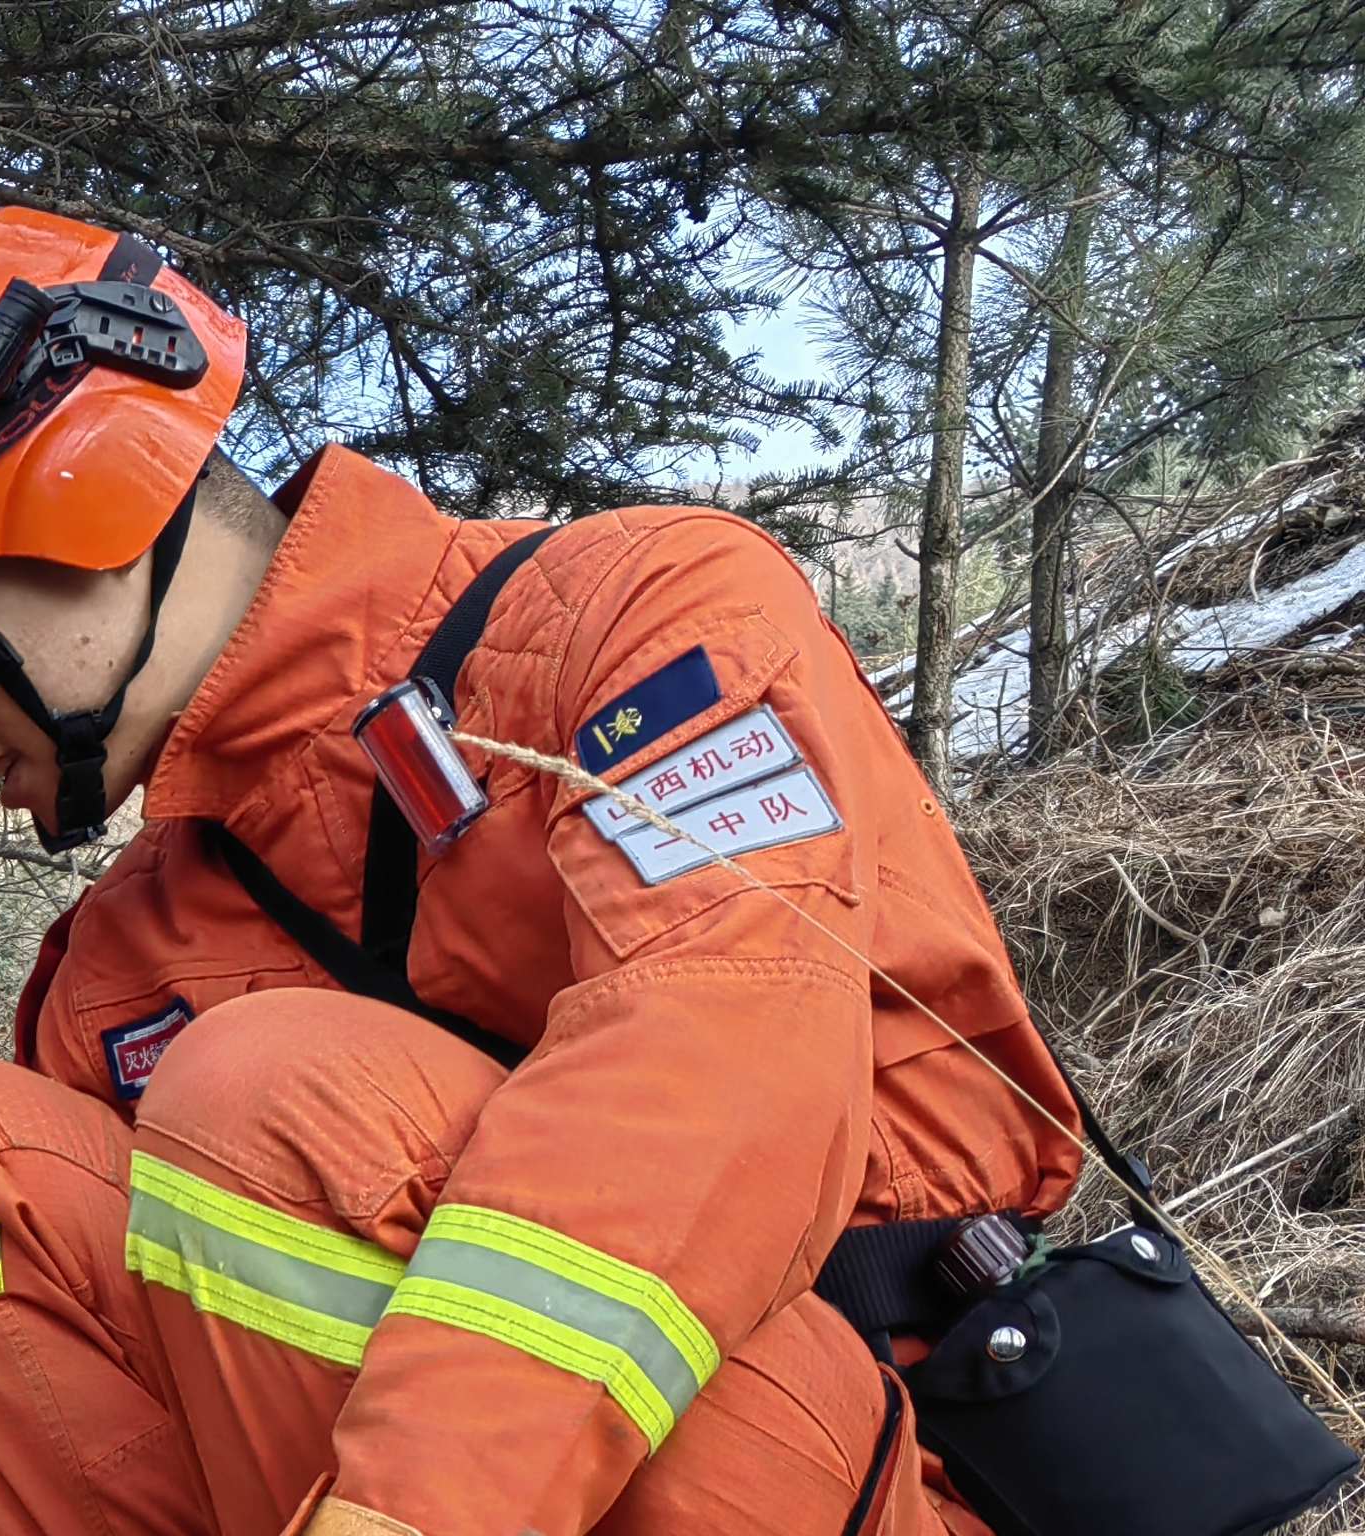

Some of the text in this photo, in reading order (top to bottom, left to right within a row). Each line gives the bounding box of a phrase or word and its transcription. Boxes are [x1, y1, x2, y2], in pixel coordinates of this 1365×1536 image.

[606, 728, 774, 821] 山西机动
[653, 791, 809, 851] 一中队
